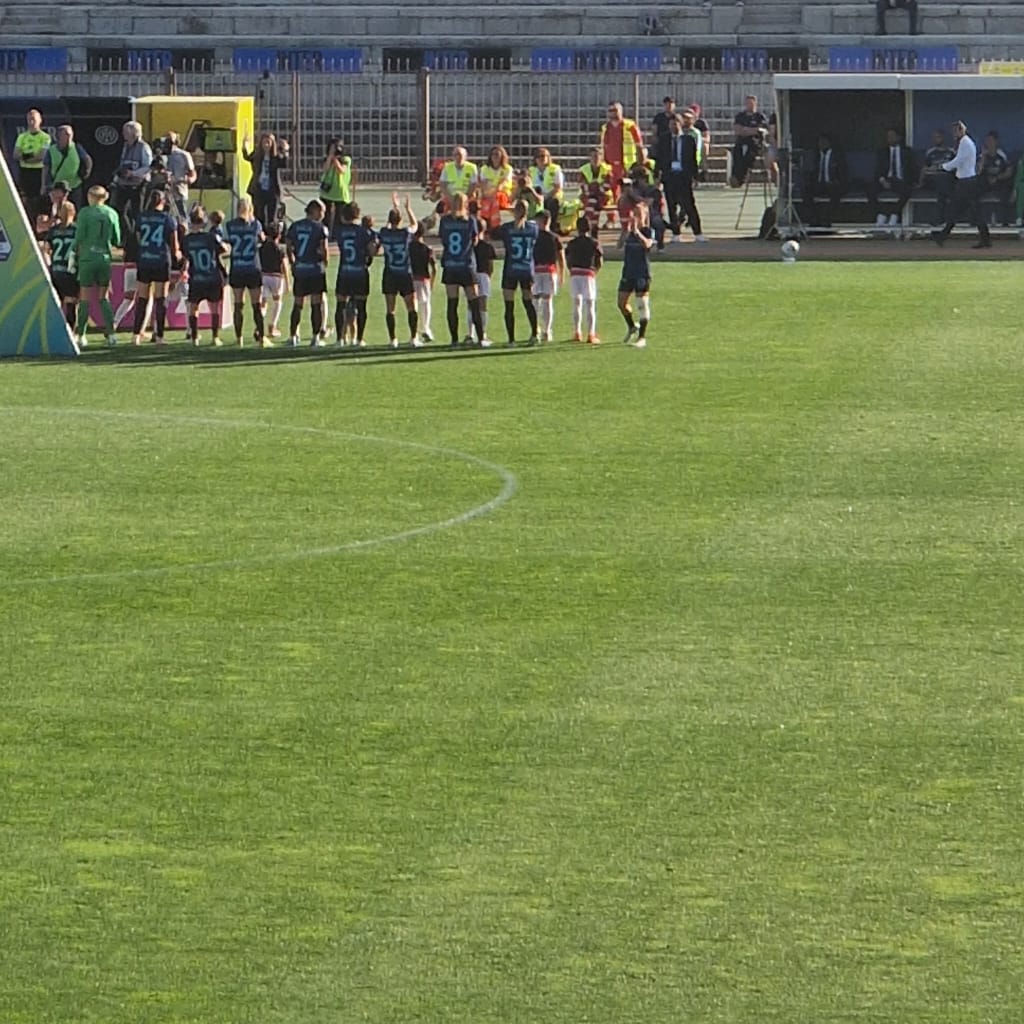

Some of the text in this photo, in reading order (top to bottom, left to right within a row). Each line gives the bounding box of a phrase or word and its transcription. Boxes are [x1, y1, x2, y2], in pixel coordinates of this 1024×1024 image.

[140, 223, 165, 247] 24
[231, 234, 254, 257] 22
[297, 233, 310, 257] 7
[448, 232, 462, 255] 8
[52, 237, 75, 261] 27
[343, 239, 357, 262] 5
[511, 236, 532, 259] 31
[189, 248, 211, 273] 10
